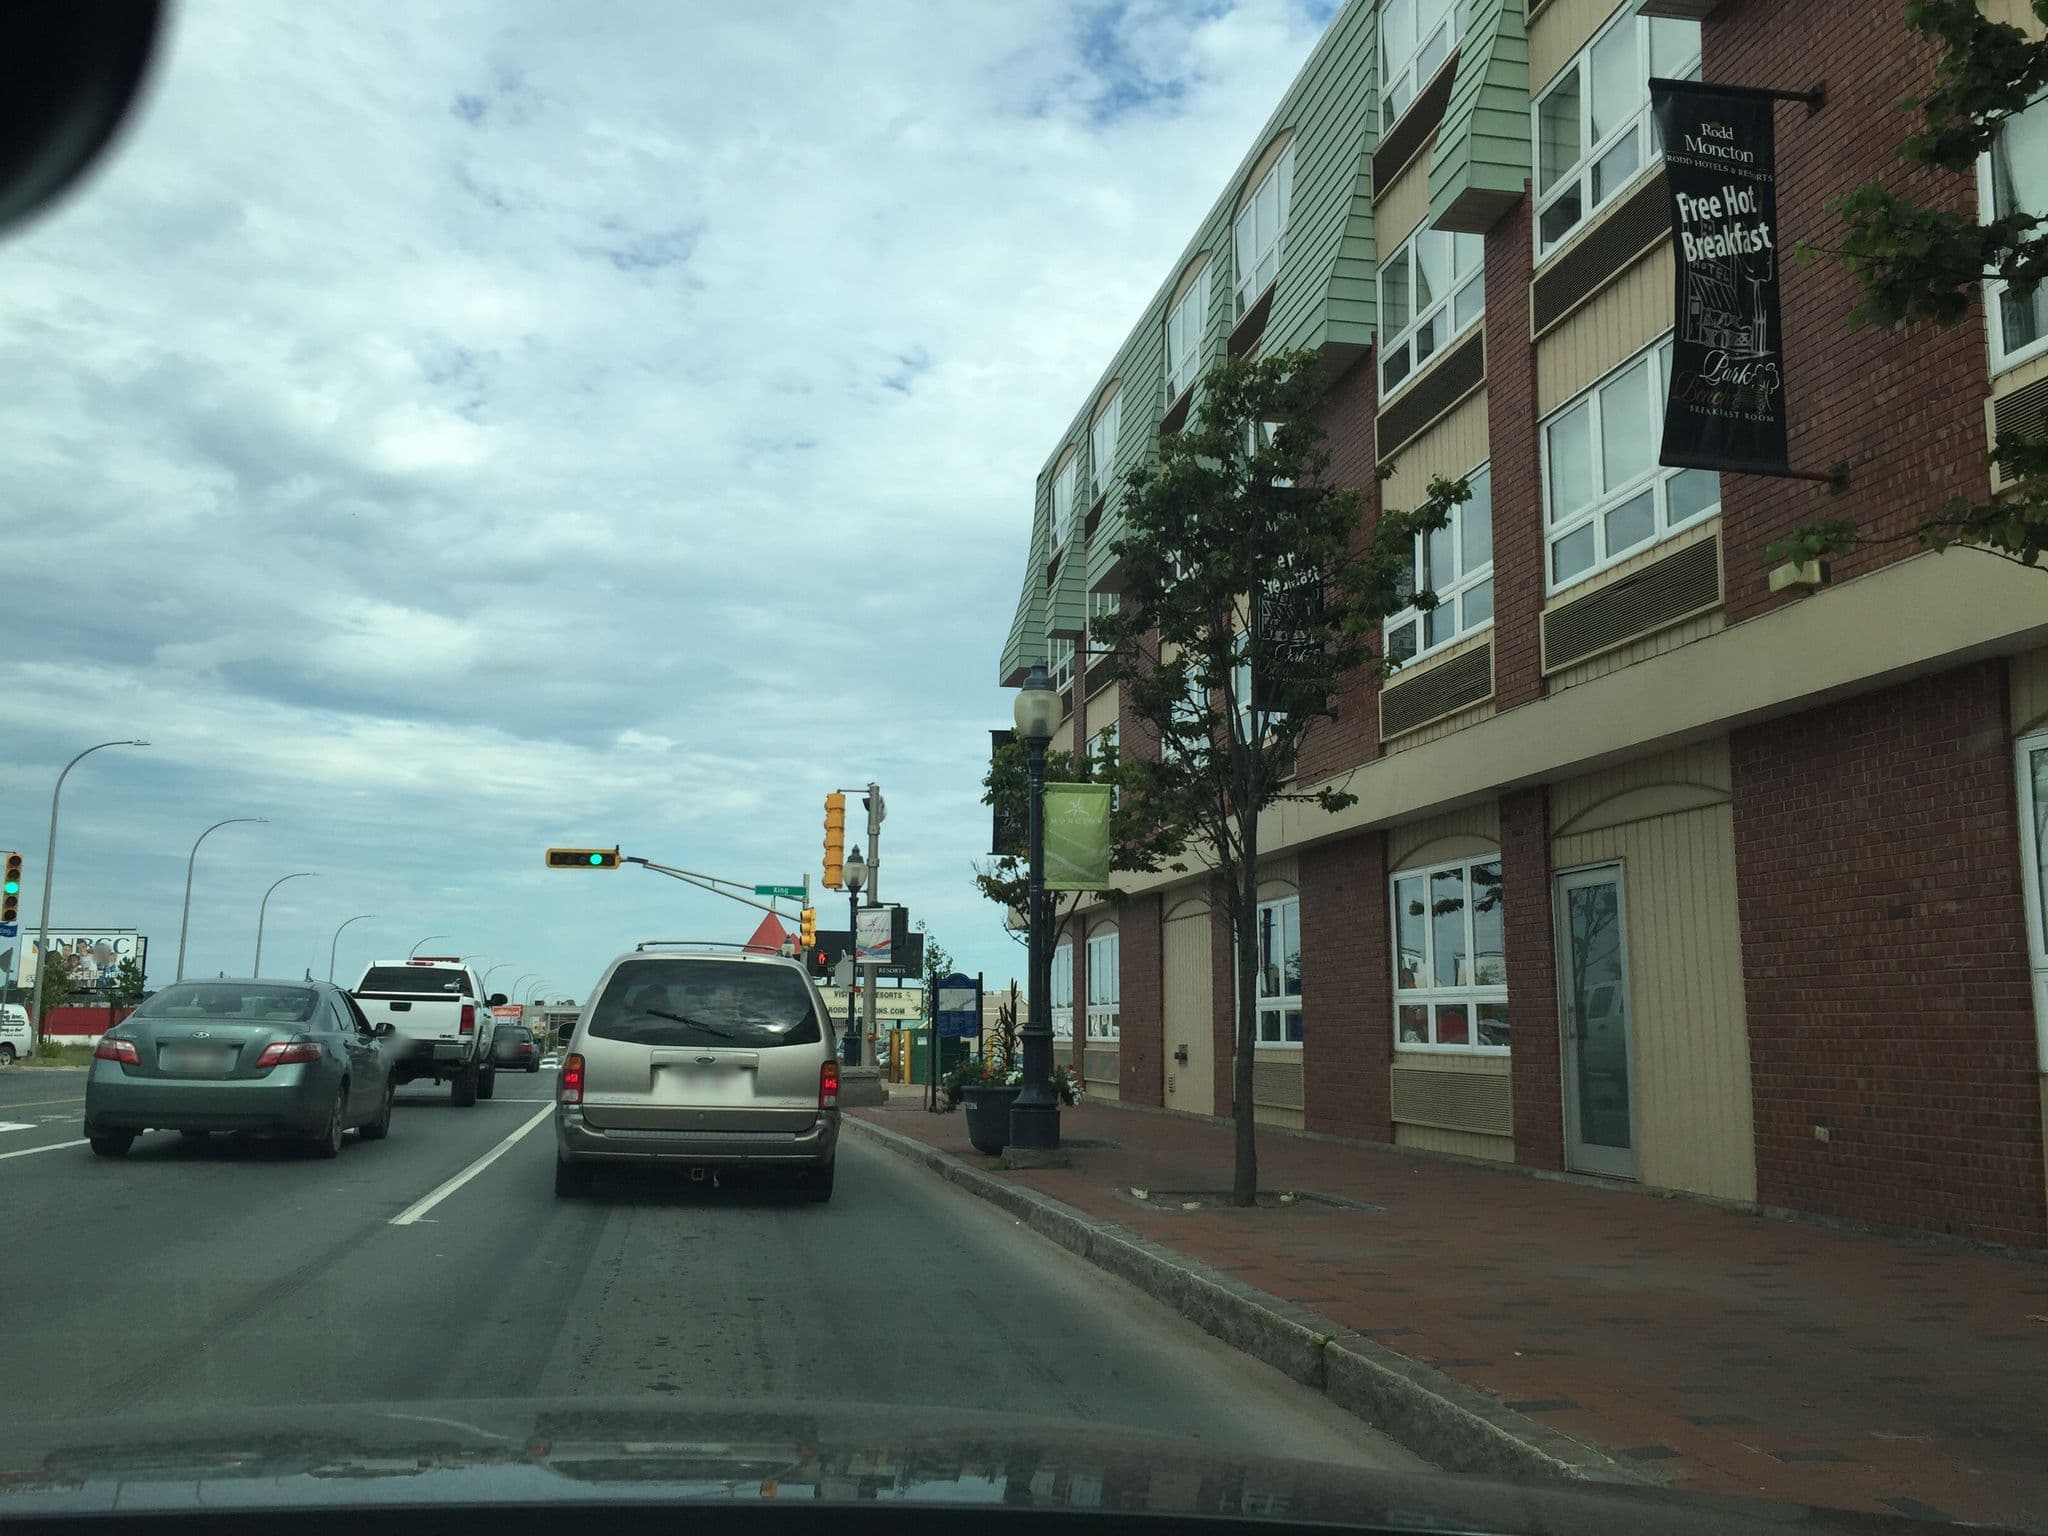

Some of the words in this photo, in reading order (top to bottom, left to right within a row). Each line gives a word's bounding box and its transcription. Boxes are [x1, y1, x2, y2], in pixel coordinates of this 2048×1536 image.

[1700, 123, 1735, 140] Rodd
[1684, 134, 1755, 164] Moncton
[1666, 154, 1693, 166] RODD
[1694, 158, 1729, 172] HOTELS
[1676, 191, 1723, 223] Free
[1722, 185, 1758, 216] Hot
[1681, 221, 1773, 263] Breakfast
[1699, 349, 1752, 386] Park
[1690, 405, 1740, 419] BREAKFAST
[1744, 411, 1775, 423] ROOM
[875, 991, 903, 999] ESORTS
